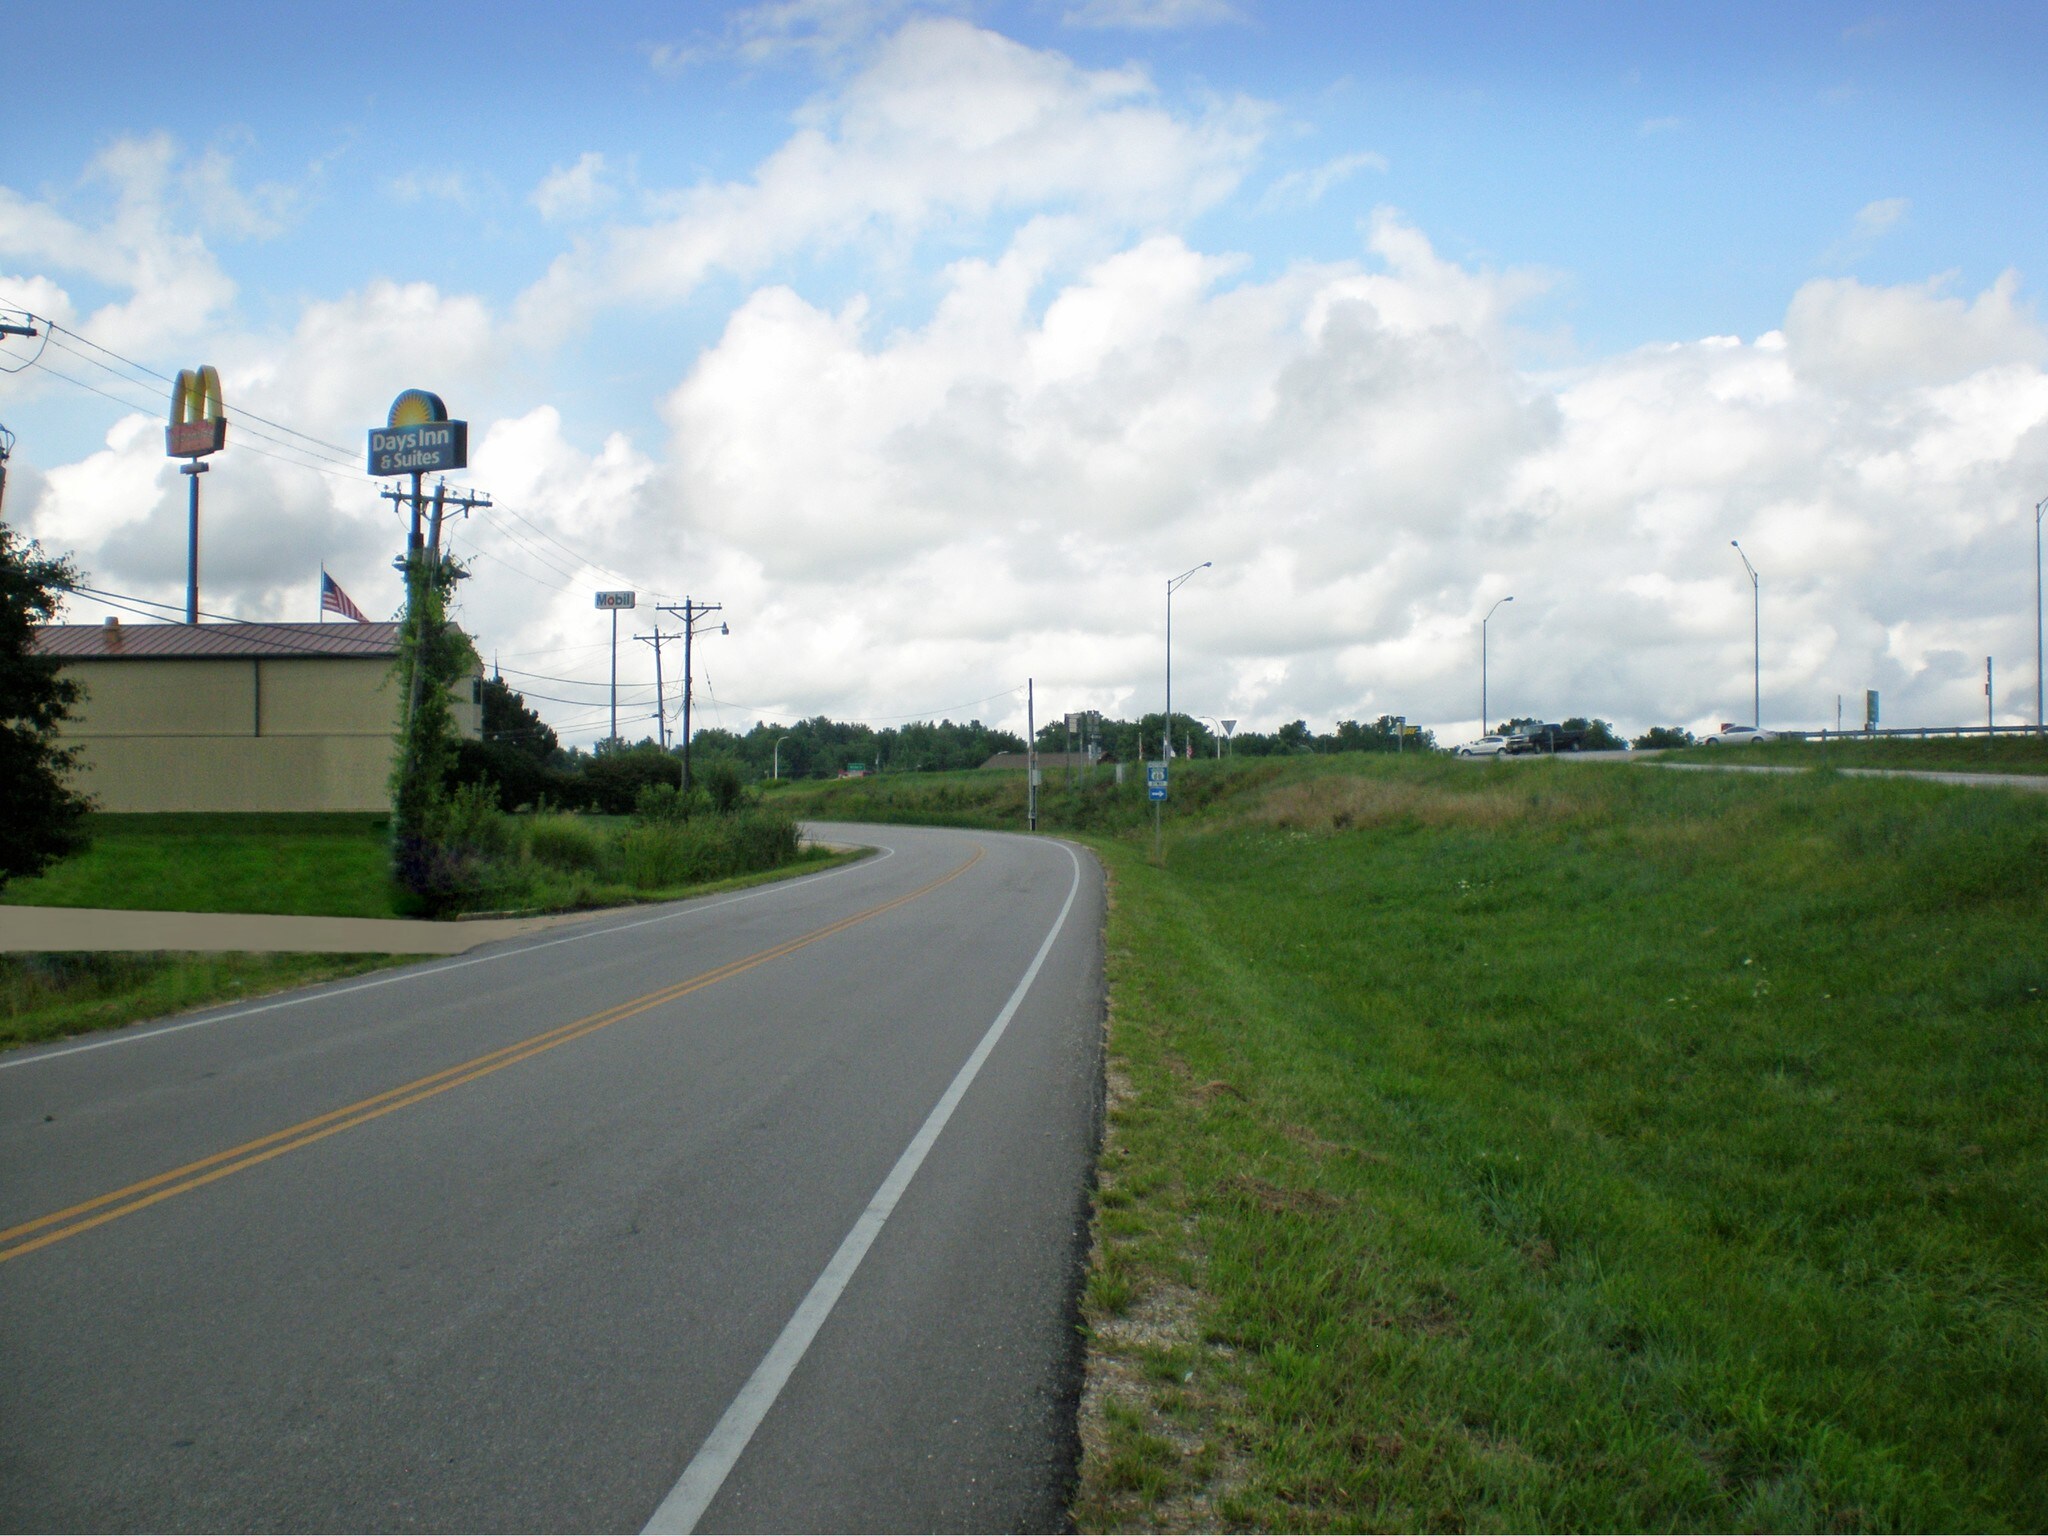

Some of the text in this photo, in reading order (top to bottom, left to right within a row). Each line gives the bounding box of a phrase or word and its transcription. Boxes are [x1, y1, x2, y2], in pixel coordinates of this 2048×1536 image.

[372, 428, 449, 452] Days Inn
[380, 450, 440, 469] & Suites
[596, 592, 630, 606] Mobil
